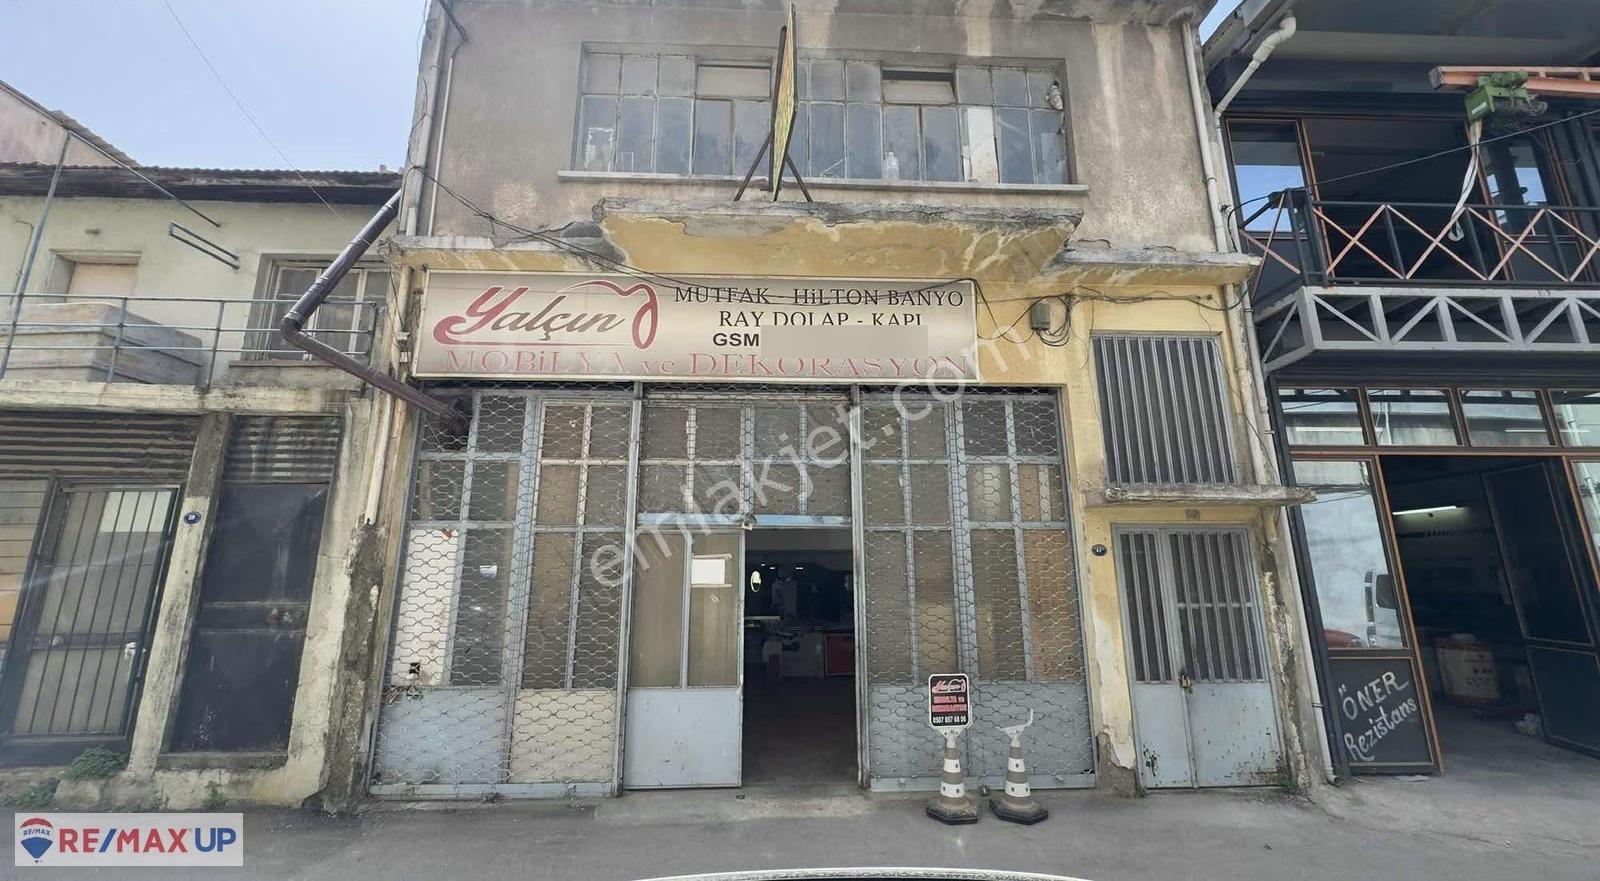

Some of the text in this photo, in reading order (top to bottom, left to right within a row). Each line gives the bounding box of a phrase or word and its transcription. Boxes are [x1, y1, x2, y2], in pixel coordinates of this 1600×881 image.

[675, 286, 770, 304] MUTFAK
[888, 290, 963, 307] BANYO
[433, 286, 626, 345] Yalçın
[719, 310, 764, 327] RAY
[773, 311, 849, 326] DOLAP
[872, 313, 922, 326] KAPI
[712, 332, 760, 347] GSM
[640, 359, 676, 374] ve
[688, 352, 967, 377] DEKORASYON
[1338, 671, 1409, 720] ÖNER
[1344, 697, 1418, 761] Rezistans
